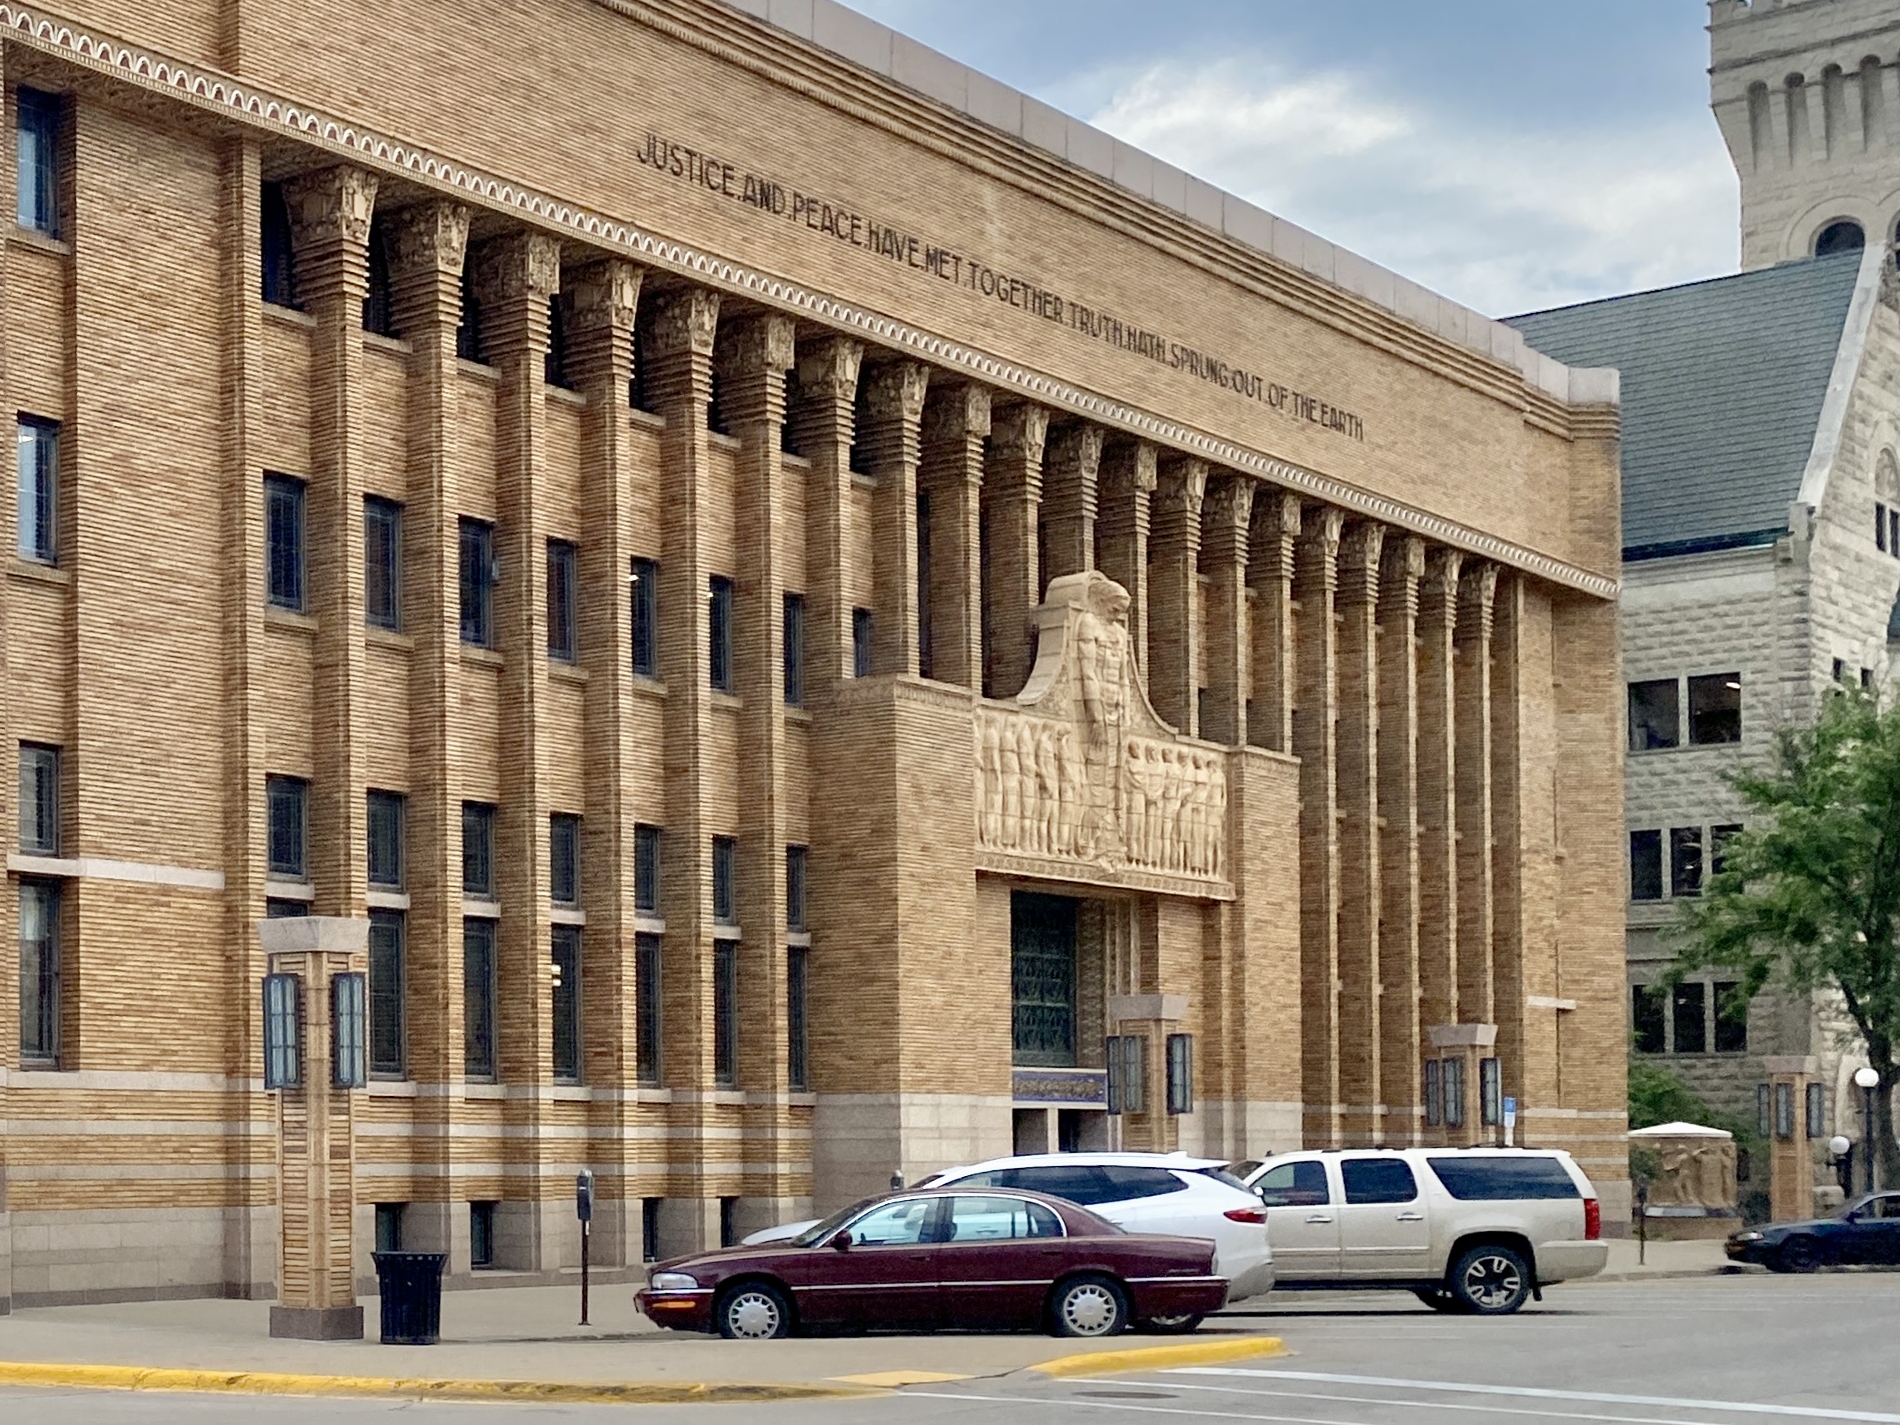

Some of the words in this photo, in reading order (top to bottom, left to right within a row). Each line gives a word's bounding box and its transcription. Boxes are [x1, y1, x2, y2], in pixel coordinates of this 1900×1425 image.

[637, 134, 734, 197] JUSTICE
[742, 174, 786, 215] AND
[793, 191, 863, 246] PEACE
[868, 220, 919, 268] HAVE
[926, 244, 962, 284] MET
[968, 261, 1064, 324] TOGETHER
[1069, 301, 1123, 347] TRUTH
[1127, 325, 1166, 364] HATH
[1171, 343, 1228, 388] SPRUNG
[1233, 370, 1263, 401] OUT
[1268, 383, 1288, 410] OF
[1292, 390, 1318, 423] THE
[1321, 403, 1363, 442] EARTH
